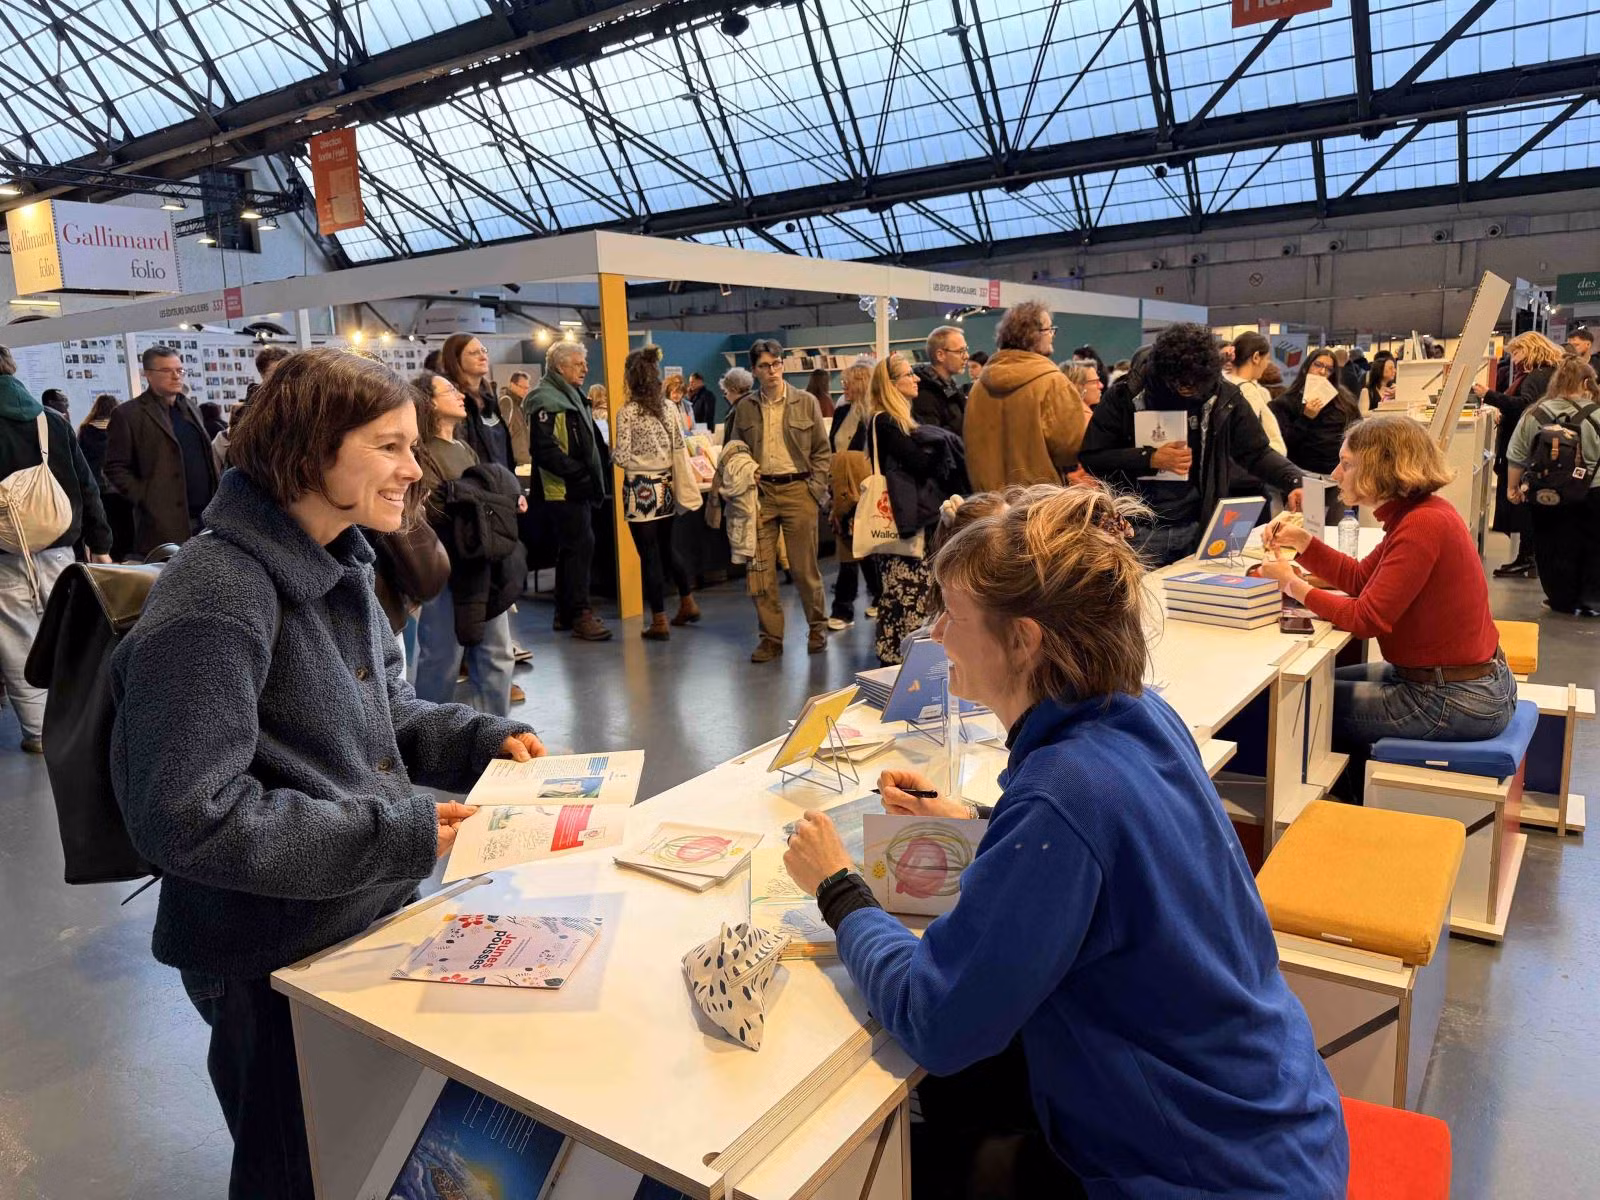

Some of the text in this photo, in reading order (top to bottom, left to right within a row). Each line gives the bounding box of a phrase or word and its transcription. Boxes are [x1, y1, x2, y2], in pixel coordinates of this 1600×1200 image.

[11, 223, 54, 253] Gallimard
[62, 223, 170, 251] Gallimard
[38, 257, 55, 278] folio
[131, 258, 166, 280] folio
[469, 930, 508, 970] pousses
[482, 933, 517, 968] Jeunes
